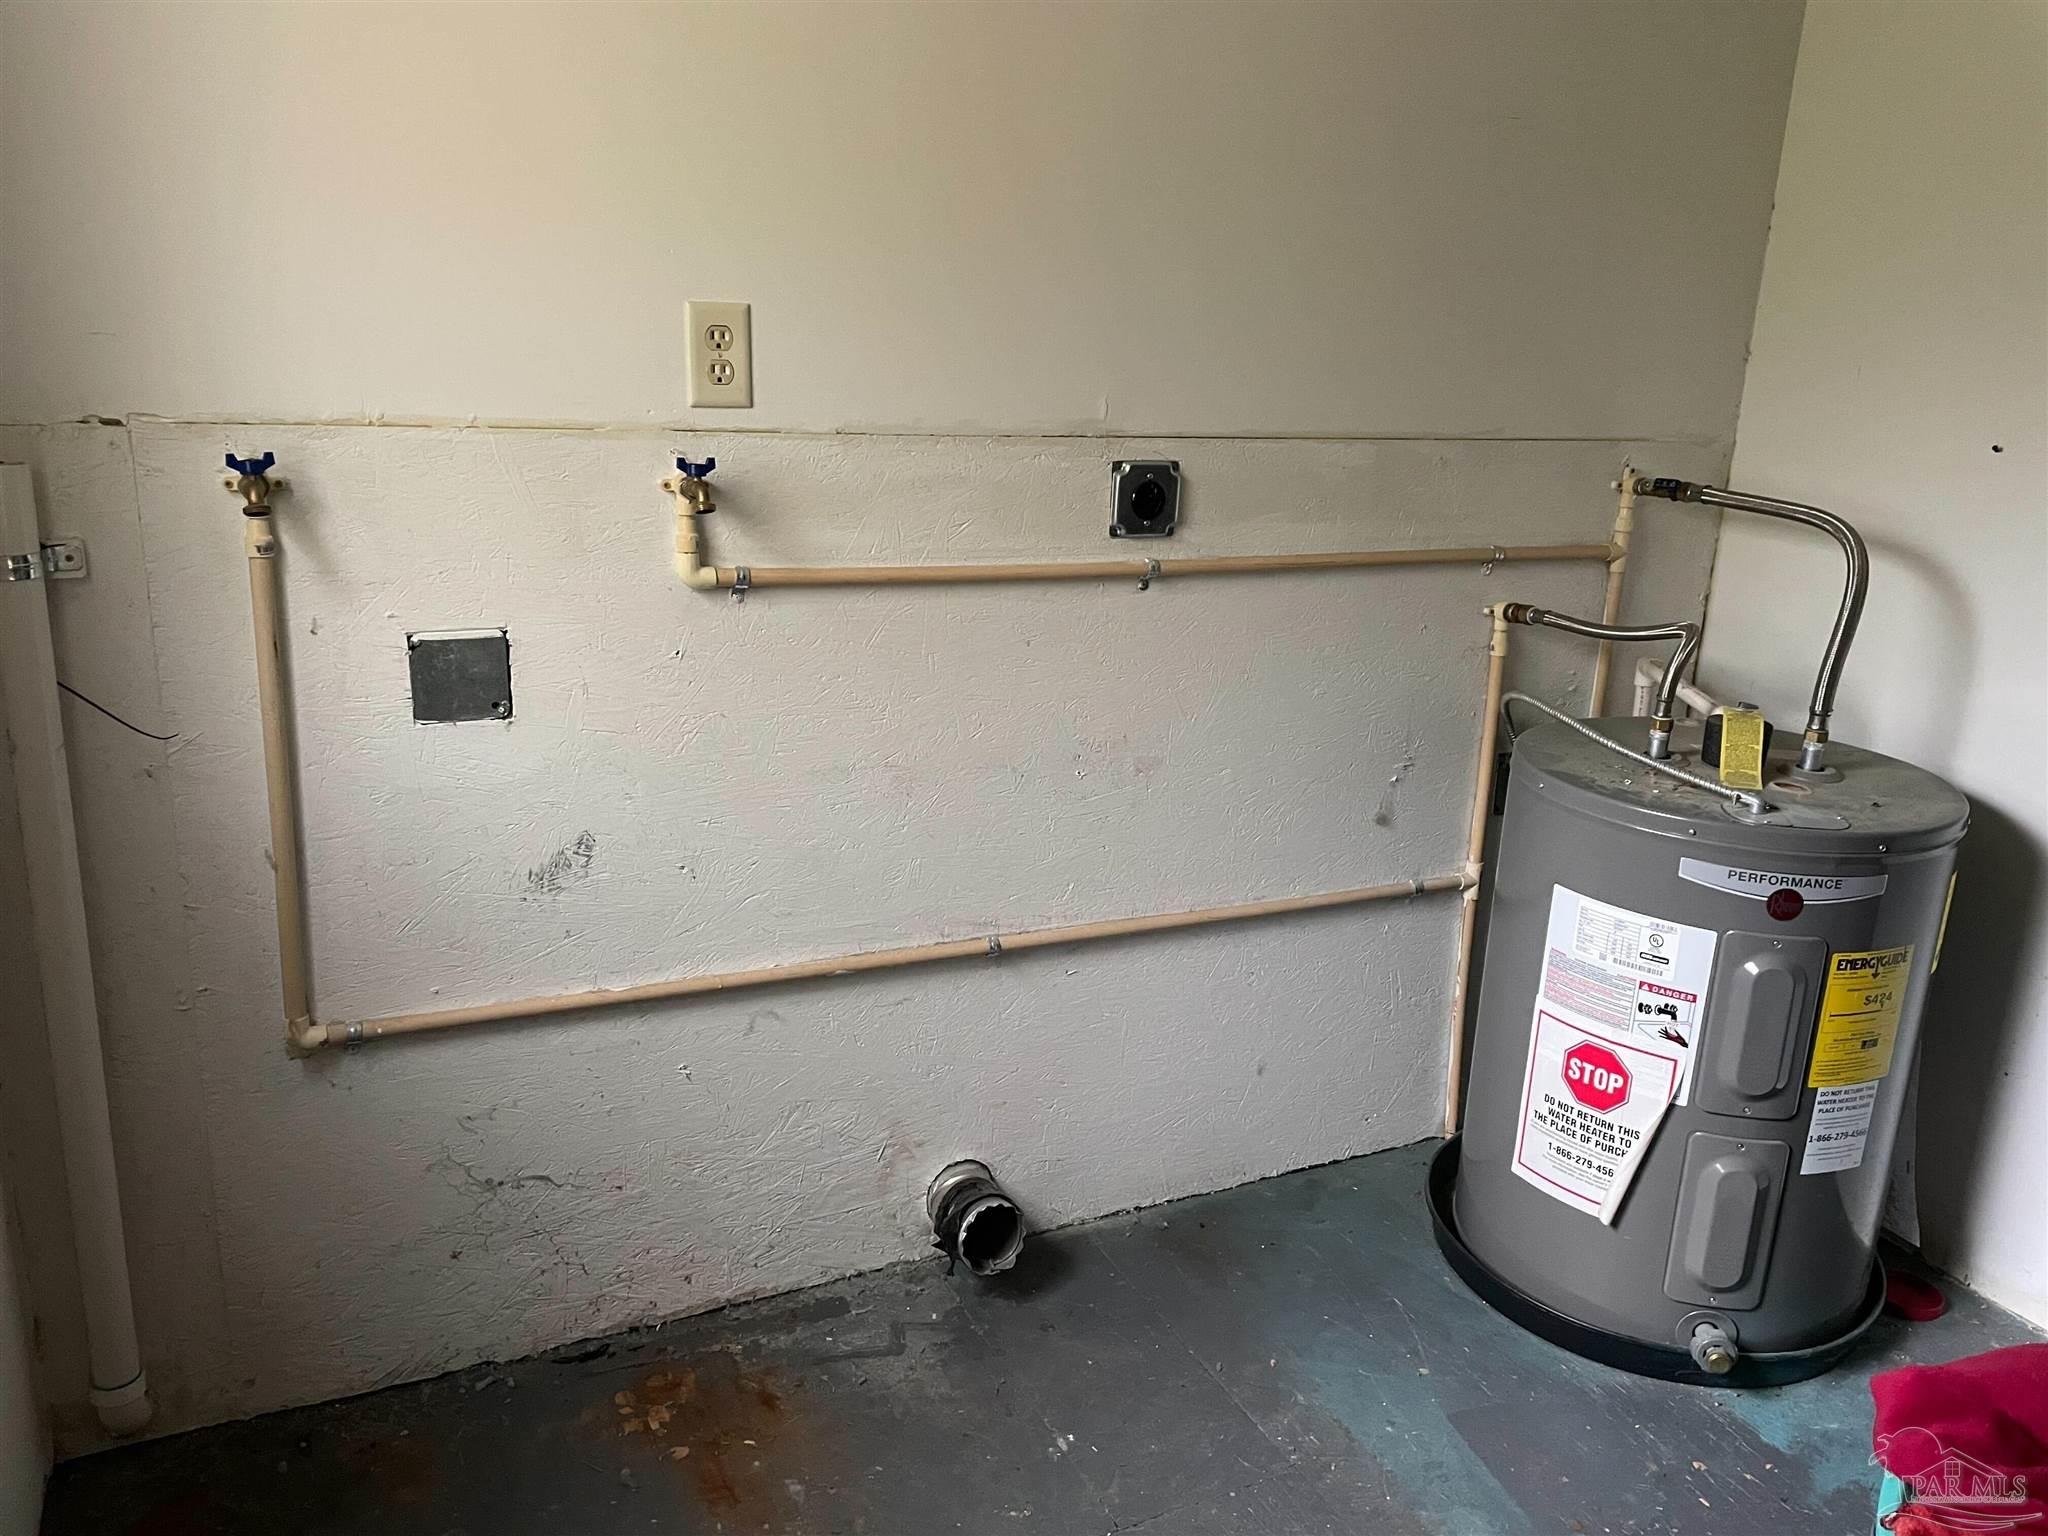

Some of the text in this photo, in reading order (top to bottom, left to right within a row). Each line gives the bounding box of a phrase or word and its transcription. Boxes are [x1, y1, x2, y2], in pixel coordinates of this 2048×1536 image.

[1727, 869, 1844, 890] PERFORMANCE
[1652, 986, 1695, 1002] DANGER
[1567, 1057, 1624, 1094] STOP
[1820, 1090, 1829, 1098] DO
[1544, 1093, 1641, 1140] DO NOT RETURN THIS
[1818, 1106, 1836, 1114] PLACE
[1533, 1110, 1548, 1125] THE
[1550, 1119, 1578, 1139] PLACE
[1580, 1133, 1593, 1145] OF
[1548, 1107, 1577, 1128] WATER
[1579, 1121, 1616, 1144] HEATER
[1620, 1137, 1632, 1149] TO
